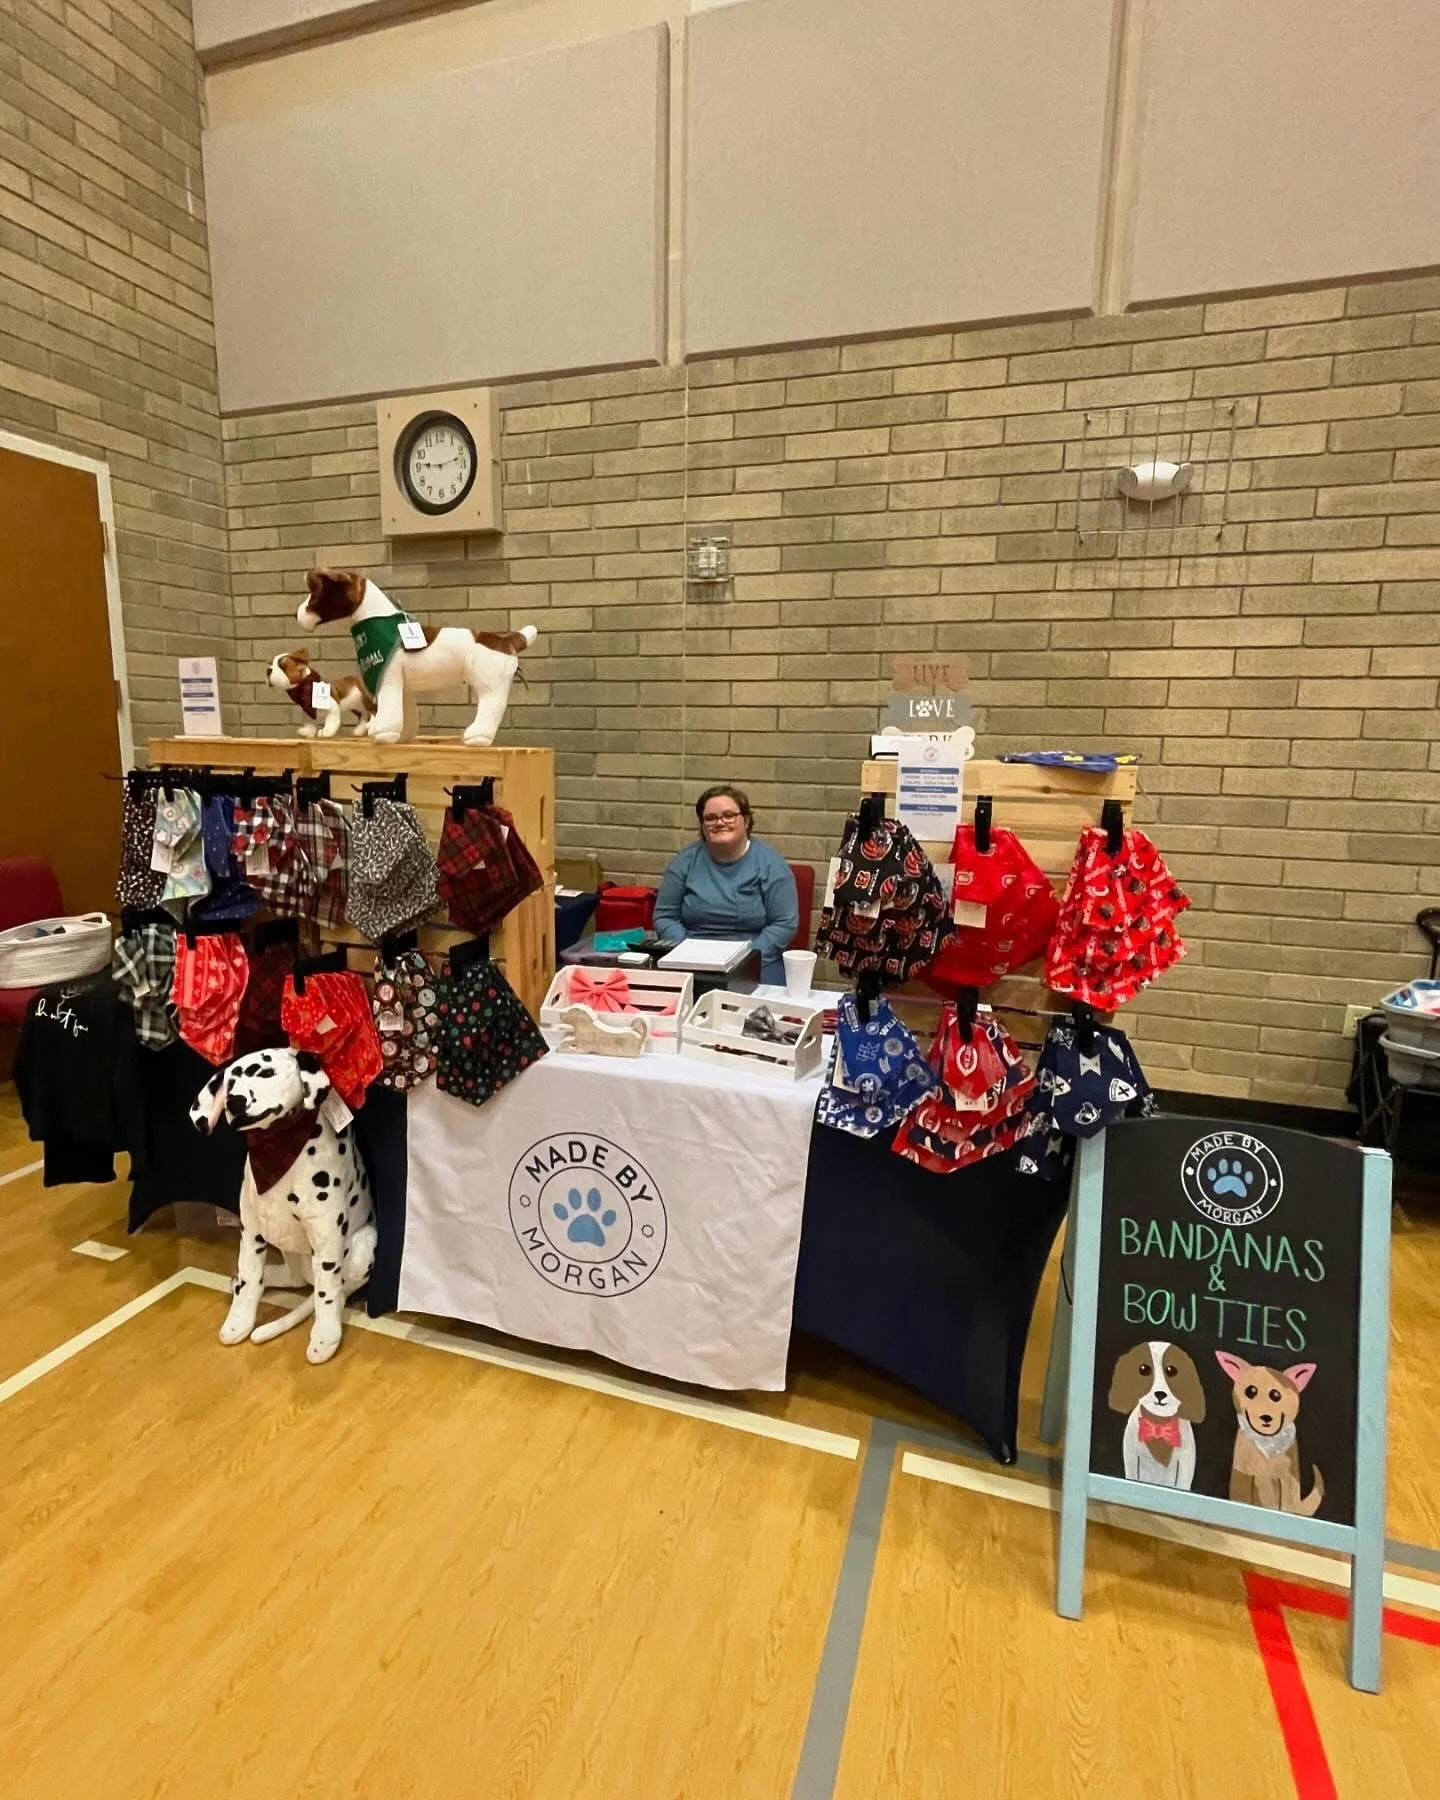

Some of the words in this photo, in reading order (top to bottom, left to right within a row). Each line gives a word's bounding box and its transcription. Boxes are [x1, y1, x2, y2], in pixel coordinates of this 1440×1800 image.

[425, 434, 432, 447] 11
[435, 431, 445, 443] 12
[416, 449, 426, 460] 10
[458, 444, 464, 456] 2
[415, 462, 421, 473] 9
[460, 457, 467, 470] 3
[420, 476, 426, 487] 8
[457, 471, 463, 483] 4
[427, 485, 433, 497] 7
[438, 488, 445, 499] 6
[451, 484, 457, 495] 5
[913, 664, 950, 683] LIVE
[1190, 1134, 1234, 1162] MADE
[1241, 1136, 1266, 1154] BY
[525, 1141, 609, 1183] MADE
[615, 1164, 654, 1202] BY
[1196, 1199, 1263, 1224] MORGAN
[1120, 1217, 1326, 1282] BANDANAS
[522, 1227, 648, 1289] MORGAN
[1208, 1263, 1226, 1292] &
[1123, 1284, 1197, 1332] BOW
[1203, 1296, 1308, 1352] TIES
